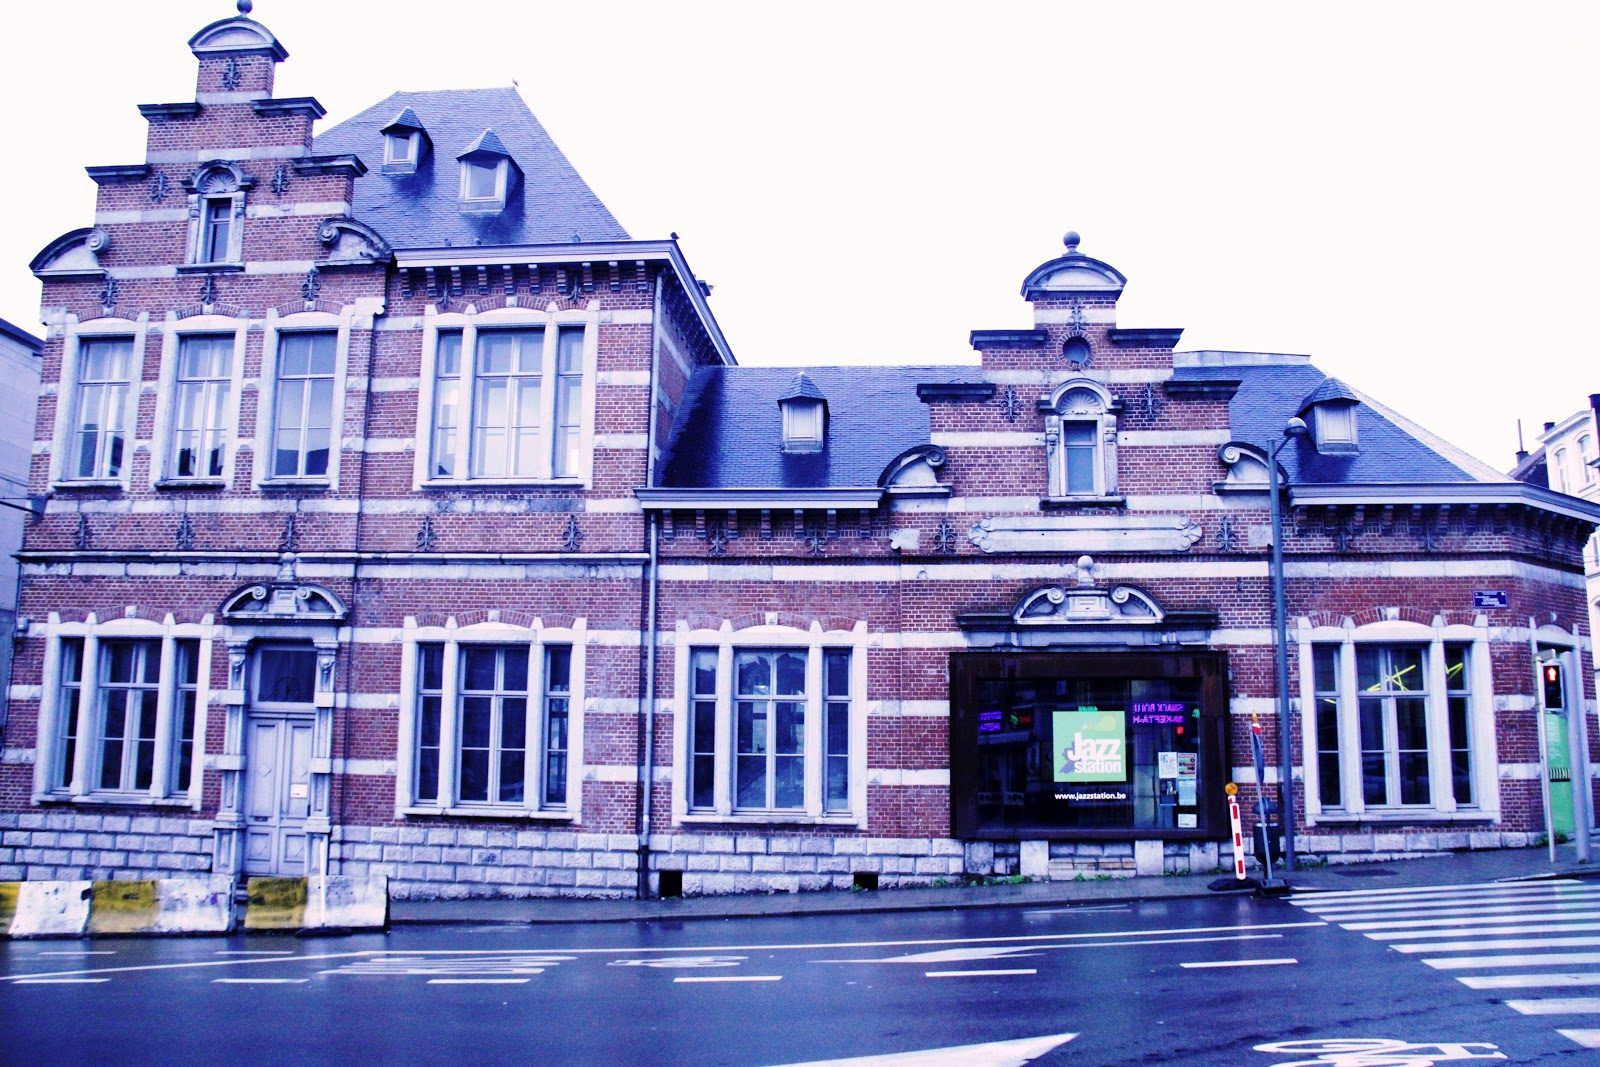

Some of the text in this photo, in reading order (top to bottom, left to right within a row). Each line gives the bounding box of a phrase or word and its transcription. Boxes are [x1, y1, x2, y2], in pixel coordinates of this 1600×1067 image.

[1067, 732, 1121, 761] Jazz
[1074, 760, 1121, 773] station
[1055, 792, 1126, 801] www.jazzstation.be
